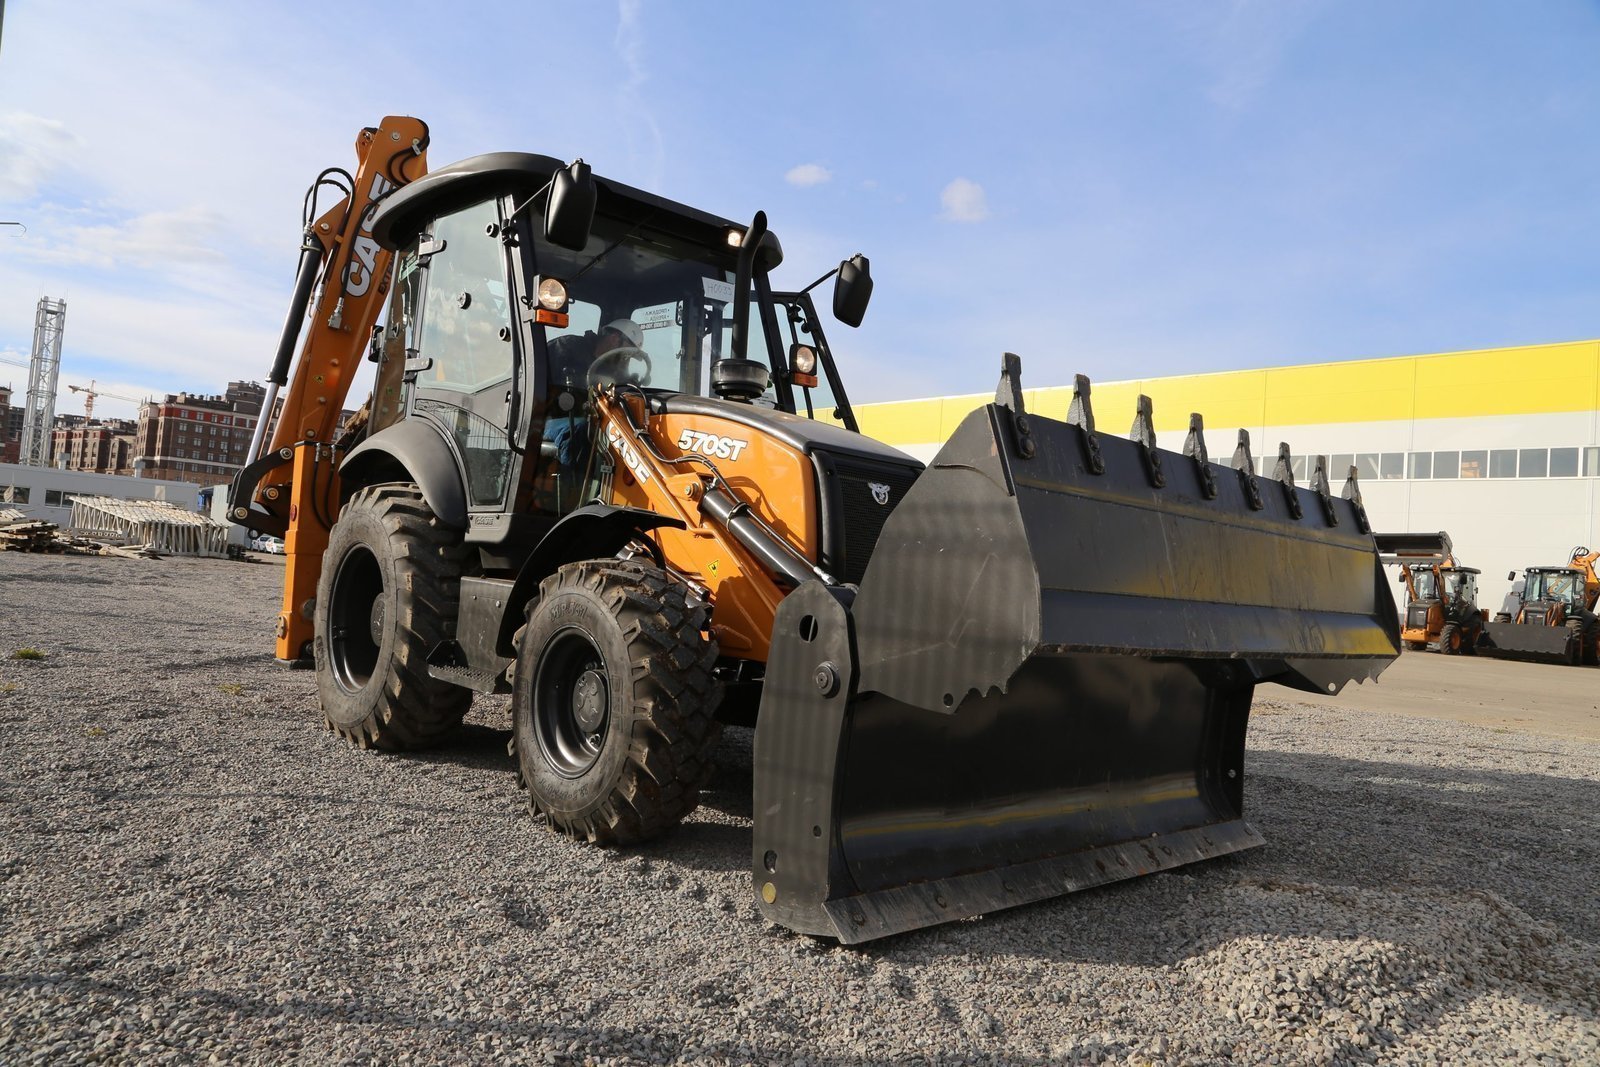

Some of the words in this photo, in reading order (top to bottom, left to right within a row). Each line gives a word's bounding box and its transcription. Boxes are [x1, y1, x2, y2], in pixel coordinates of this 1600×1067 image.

[342, 171, 400, 297] CASE
[605, 420, 650, 484] CASE
[678, 428, 748, 461] 570ST
